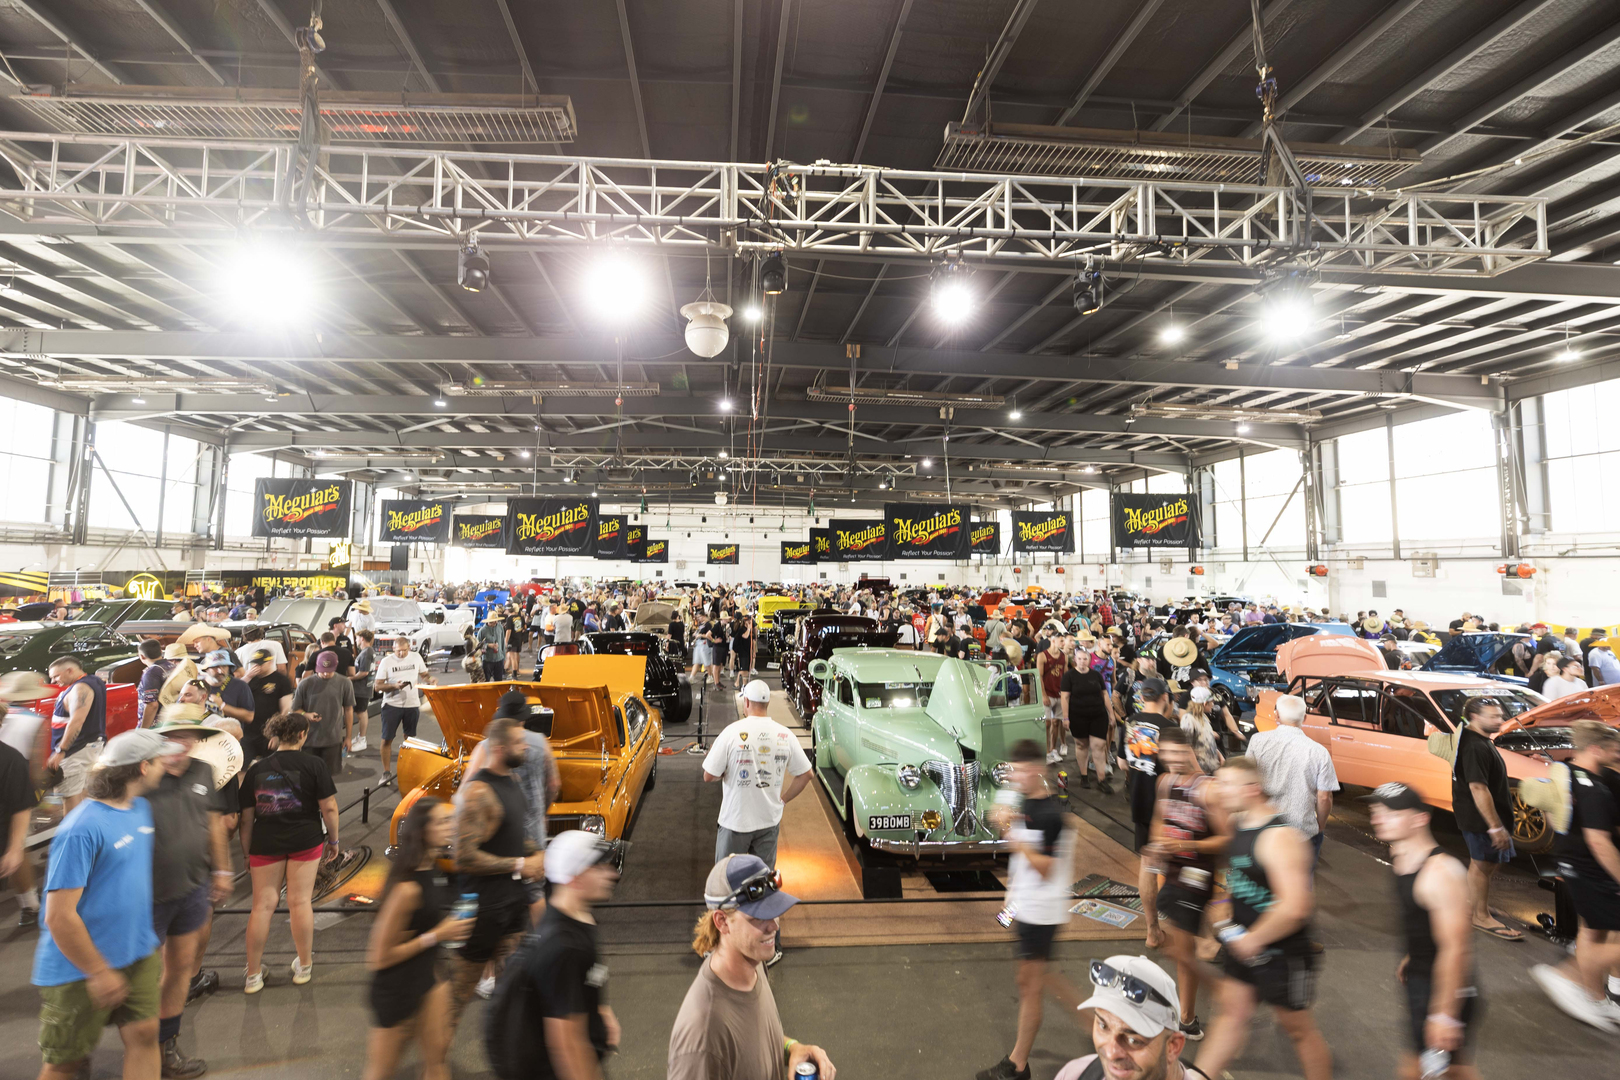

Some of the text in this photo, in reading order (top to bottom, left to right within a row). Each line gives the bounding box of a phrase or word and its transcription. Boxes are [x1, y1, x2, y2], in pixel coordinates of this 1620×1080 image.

[263, 484, 340, 522] Meguiar's
[1124, 498, 1188, 534] Meguiar's
[387, 504, 442, 532] Meguiar's
[458, 518, 502, 540] Meguiar's
[516, 503, 589, 541] Meguiar's
[893, 508, 961, 545] Meguiar's
[1018, 514, 1066, 542] Meguiar's
[836, 523, 885, 550] Meguiar's
[282, 577, 346, 588] PRODUCTS
[870, 816, 910, 828] 39BOMB
